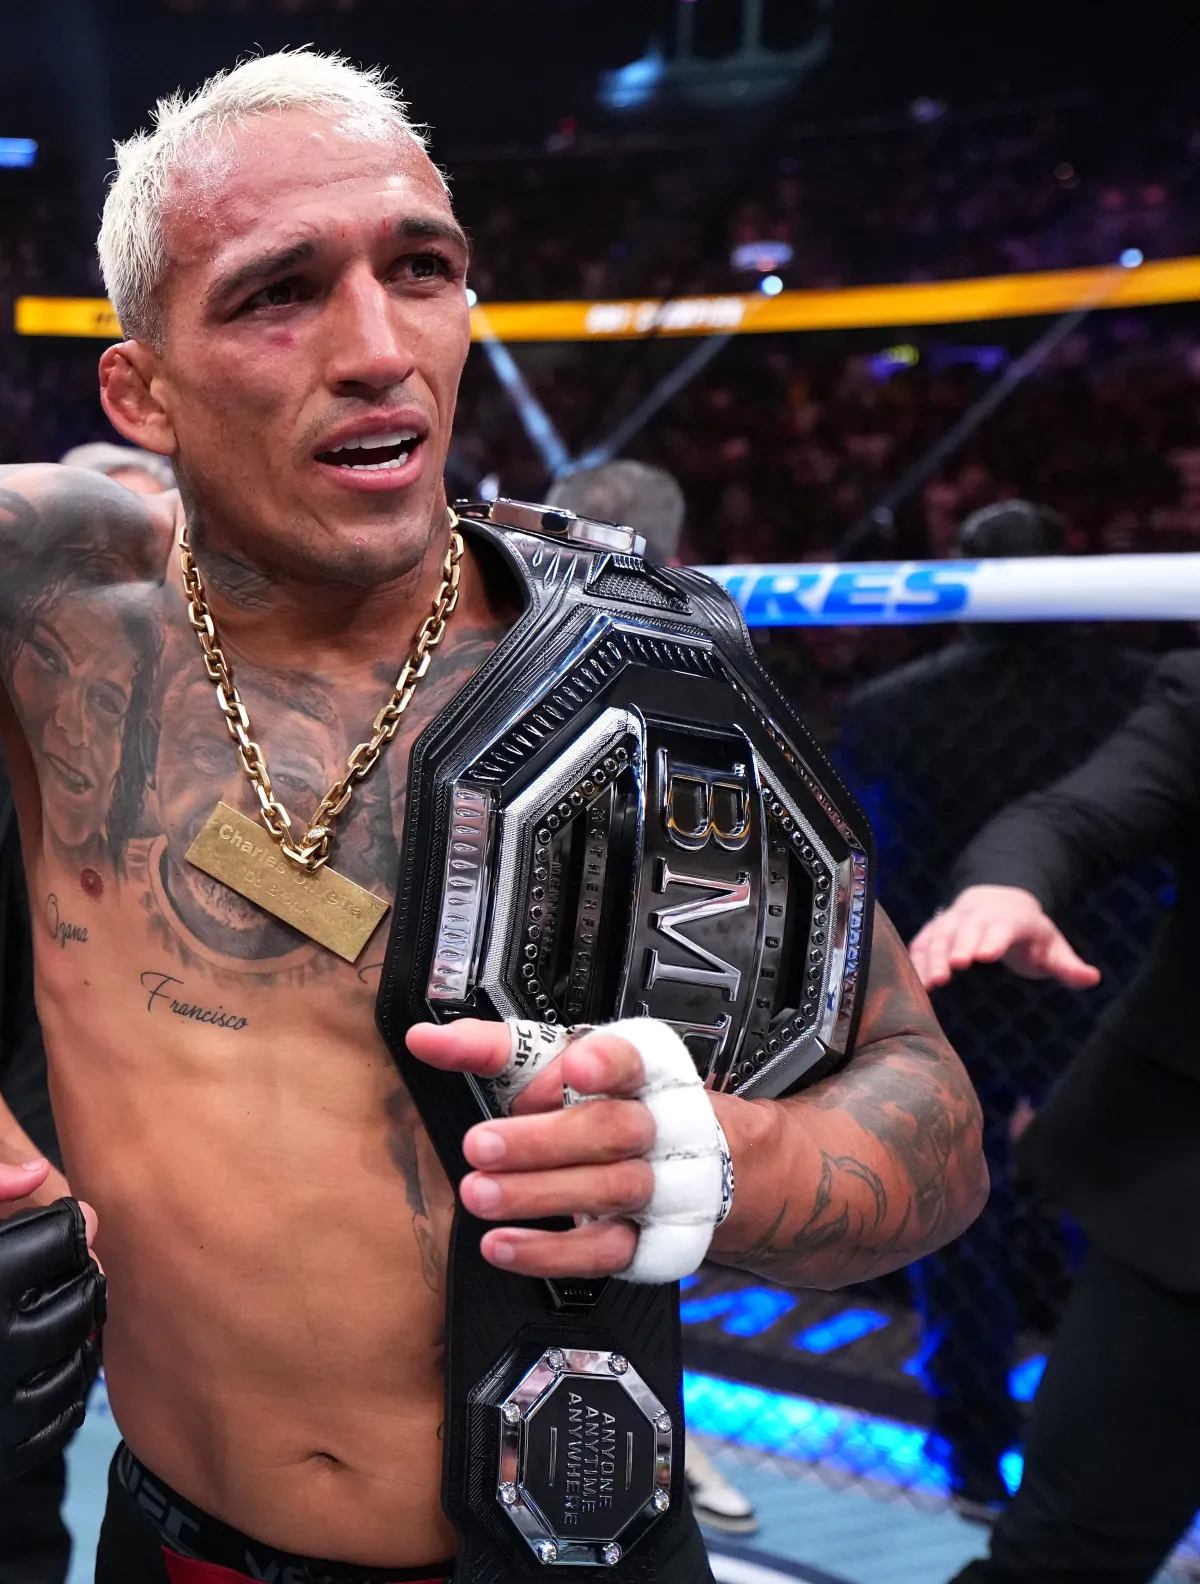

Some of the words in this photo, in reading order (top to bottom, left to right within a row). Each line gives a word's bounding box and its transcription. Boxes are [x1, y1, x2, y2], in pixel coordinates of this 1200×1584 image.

[218, 823, 288, 875] Charles
[568, 807, 605, 1014] MOTHERFUCKER
[140, 971, 249, 1031] Francisco
[515, 1024, 533, 1068] UFC
[564, 1391, 583, 1525] ANYWHERE
[582, 1405, 599, 1513] ANYTIME
[599, 1412, 616, 1508] ANYONE
